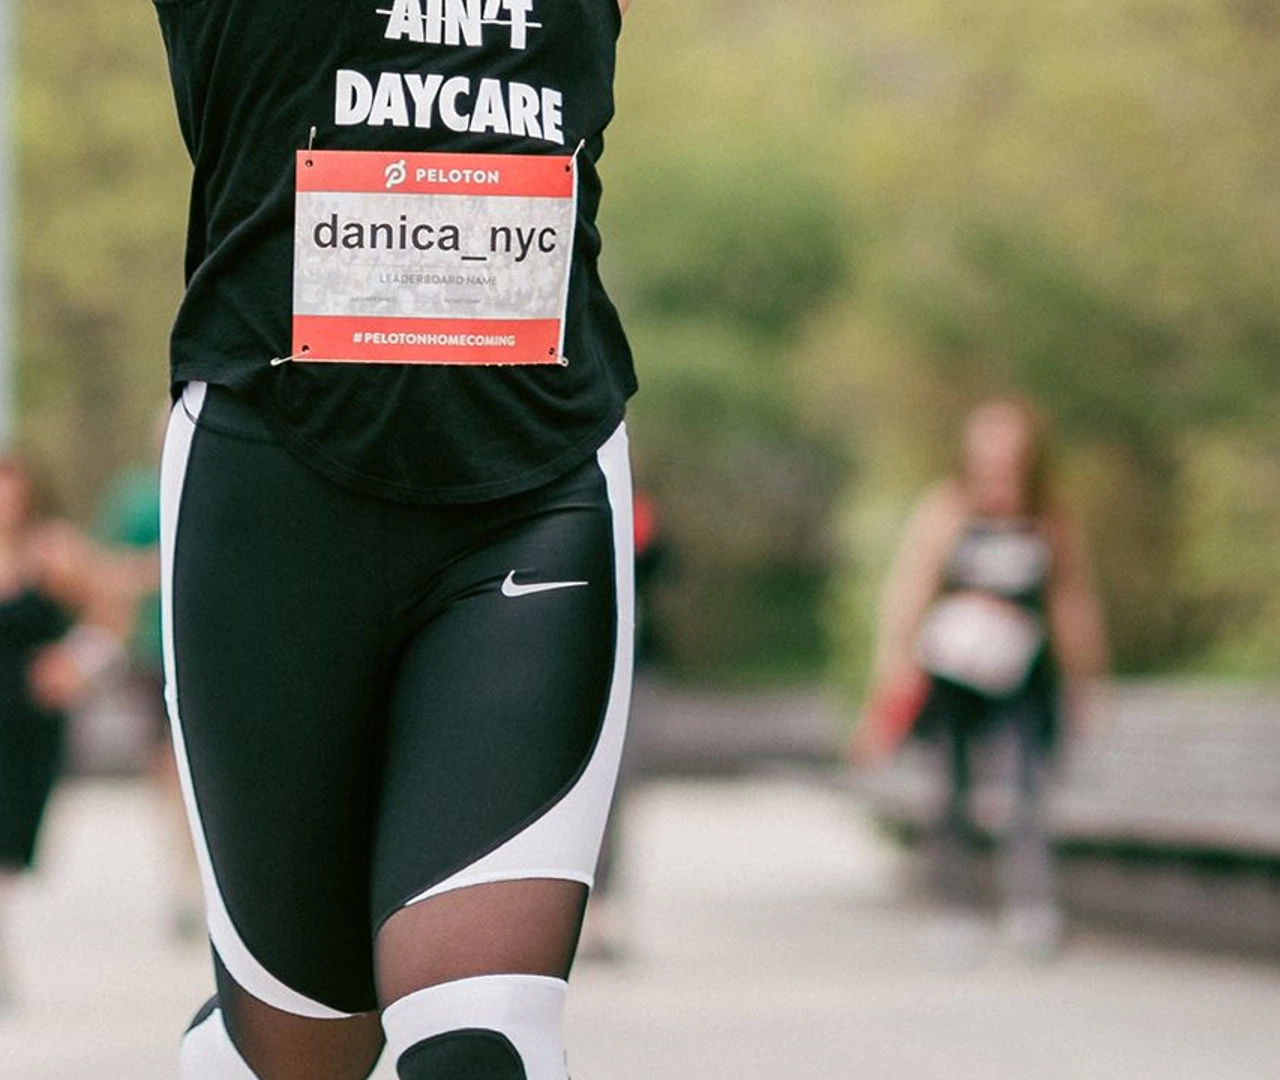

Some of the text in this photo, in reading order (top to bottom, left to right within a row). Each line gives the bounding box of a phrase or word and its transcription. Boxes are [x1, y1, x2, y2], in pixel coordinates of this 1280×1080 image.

[334, 69, 565, 145] DAYCARE
[415, 168, 499, 185] PELOTON
[313, 213, 557, 262] danica_nyc
[379, 274, 497, 286] LEADERBOARD NAME
[353, 332, 515, 347] #PELOTONHOMECOMING
